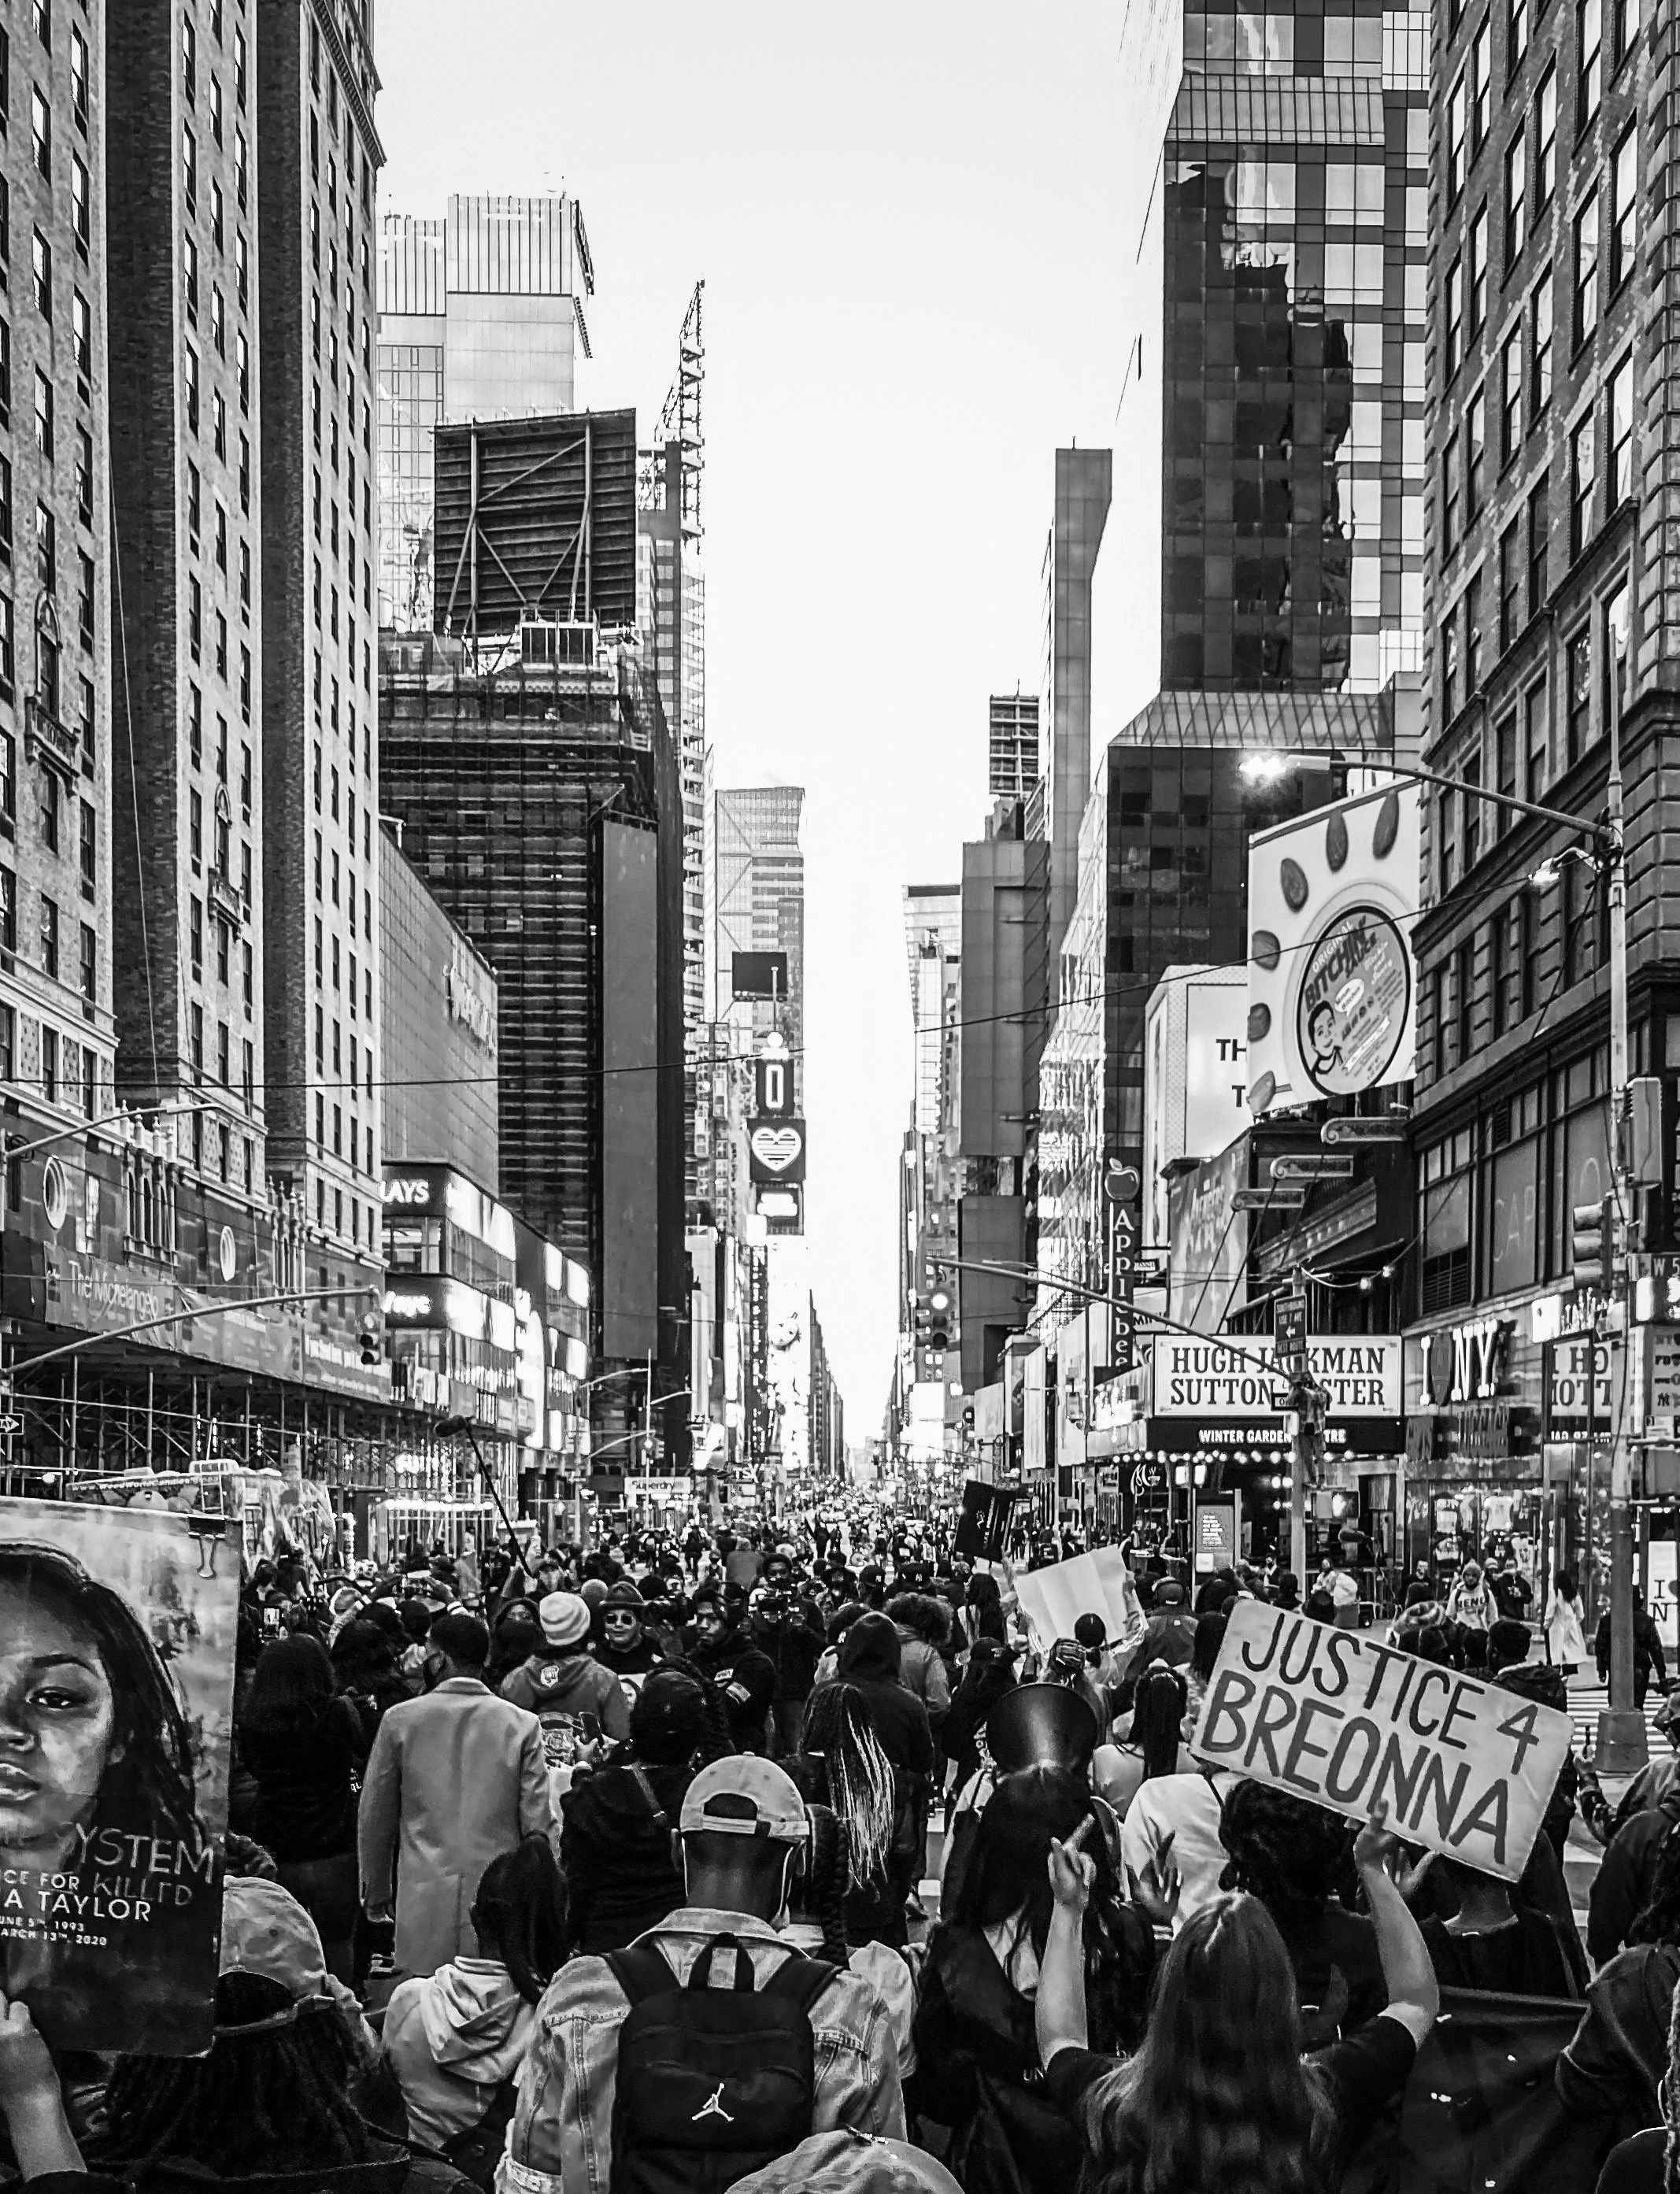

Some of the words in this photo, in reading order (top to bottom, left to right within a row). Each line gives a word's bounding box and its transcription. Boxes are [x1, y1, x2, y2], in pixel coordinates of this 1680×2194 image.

[1171, 1347, 1248, 1374] HUGH
[1171, 1378, 1275, 1405] SUTTON
[1199, 1430, 1244, 1443] WINTER
[1246, 1430, 1292, 1443] GARDEN
[1654, 1579, 1665, 1599] I
[1240, 1612, 1486, 1751] JUSTICE
[1495, 1704, 1540, 1775] 4
[1199, 1668, 1509, 1865] BREONNA
[40, 1872, 80, 1890] FOR
[38, 1890, 151, 1922] TAYLOR
[54, 1920, 84, 1932] 1993
[75, 1934, 107, 1947] 2020
